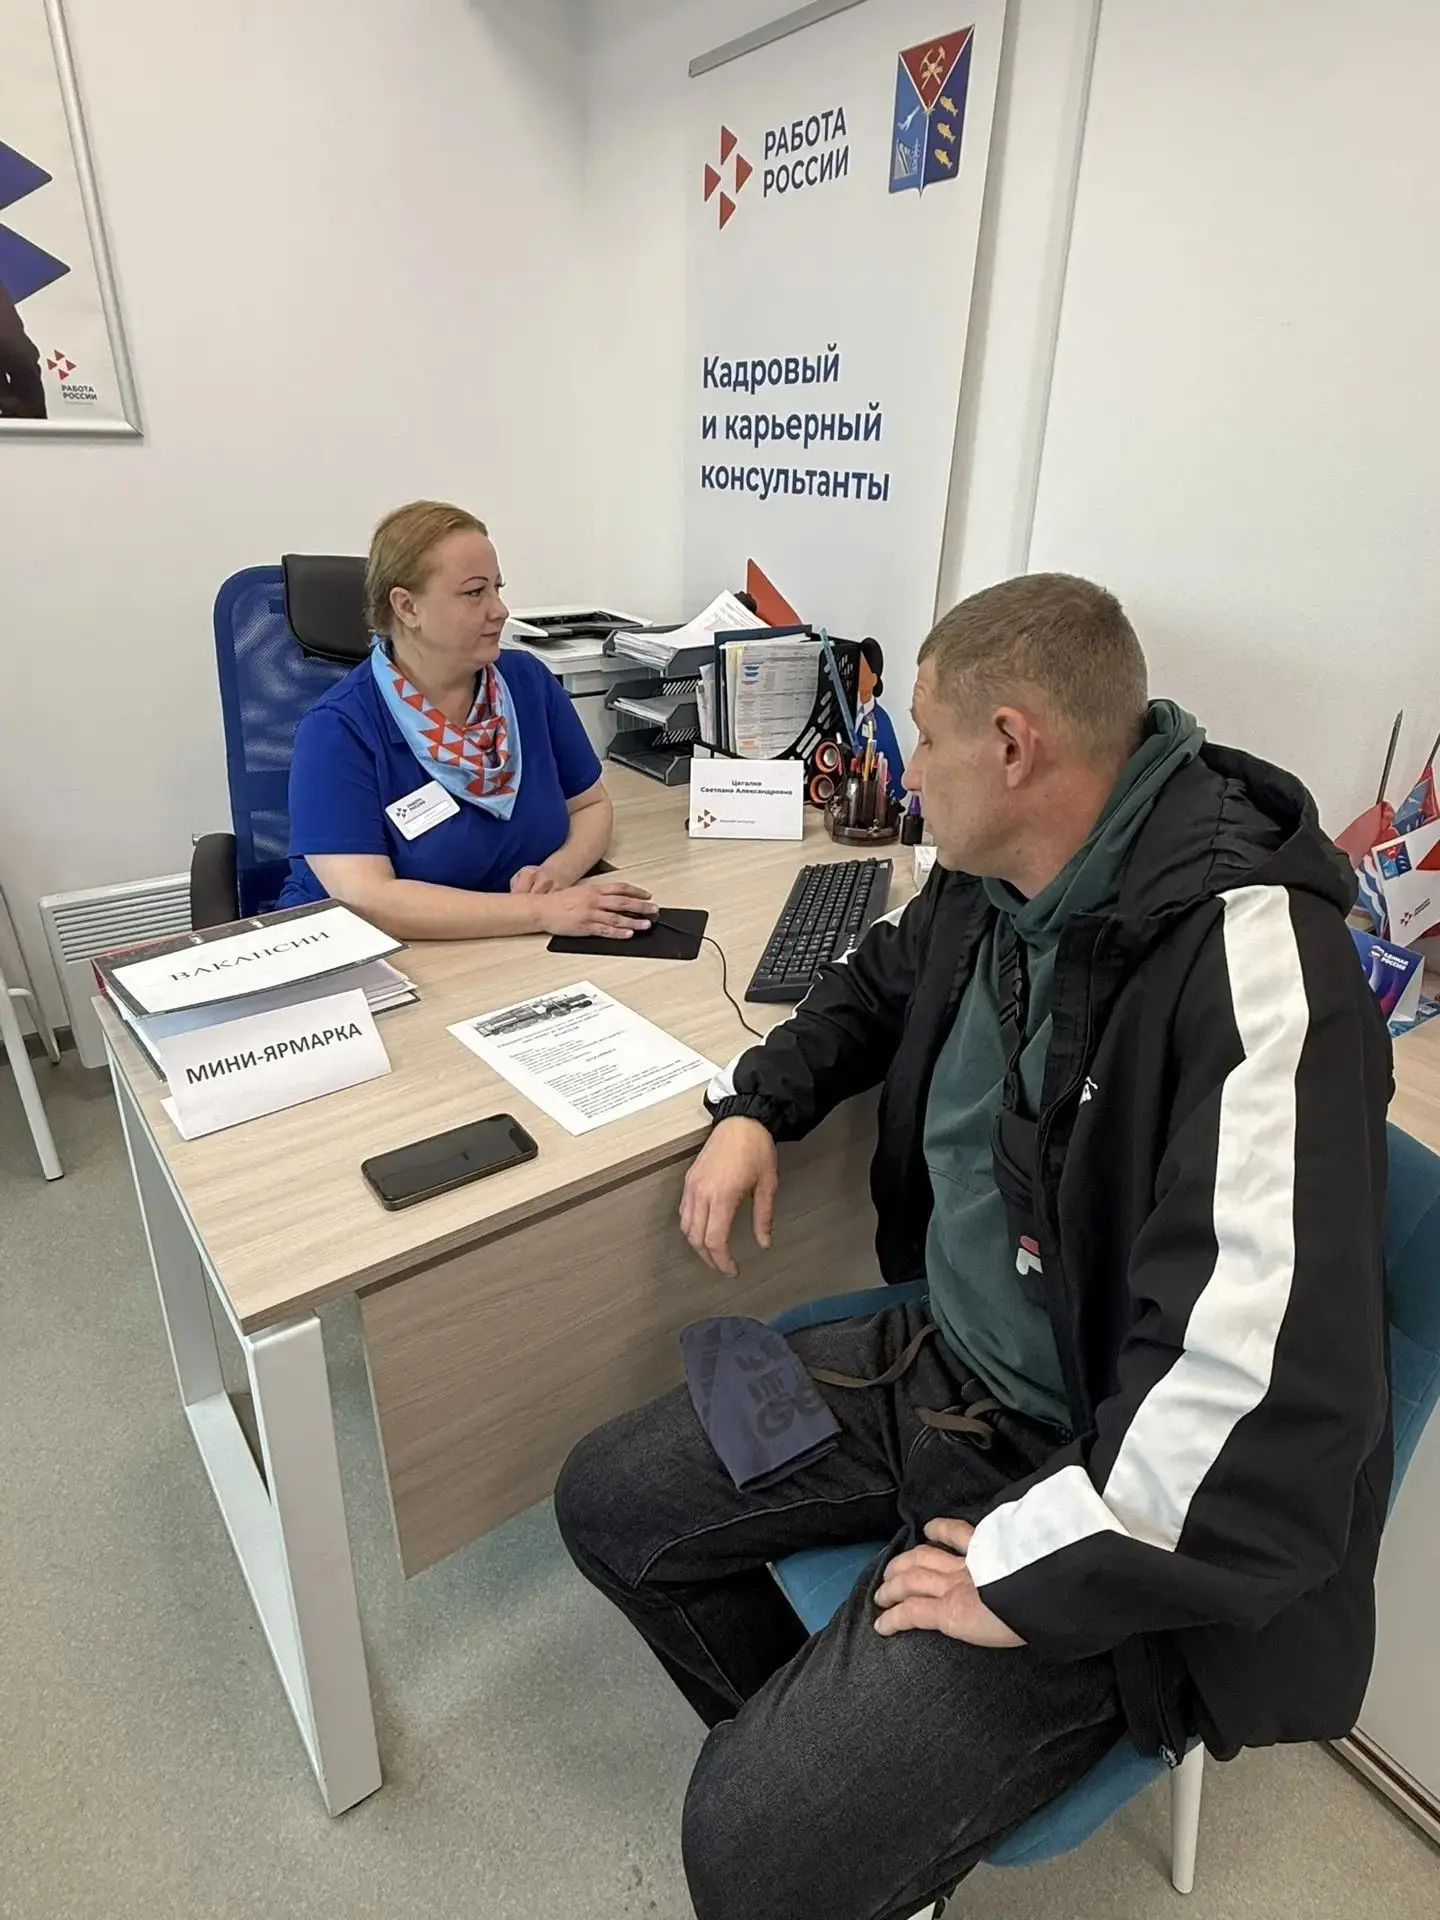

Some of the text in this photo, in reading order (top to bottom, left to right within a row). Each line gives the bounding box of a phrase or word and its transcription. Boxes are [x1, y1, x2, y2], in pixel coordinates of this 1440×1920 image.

[764, 107, 847, 160] РАБОТА
[763, 145, 849, 198] РОССИИ
[61, 384, 94, 392] РАБОТА
[703, 343, 840, 395] Кадровый
[63, 392, 97, 400] РОССИИ
[702, 401, 882, 449] и карьерный
[701, 465, 890, 501] консультанты
[169, 931, 331, 981] ВАКАНСИИ
[185, 1022, 363, 1084] МИНИ-ЯРМАРКА
